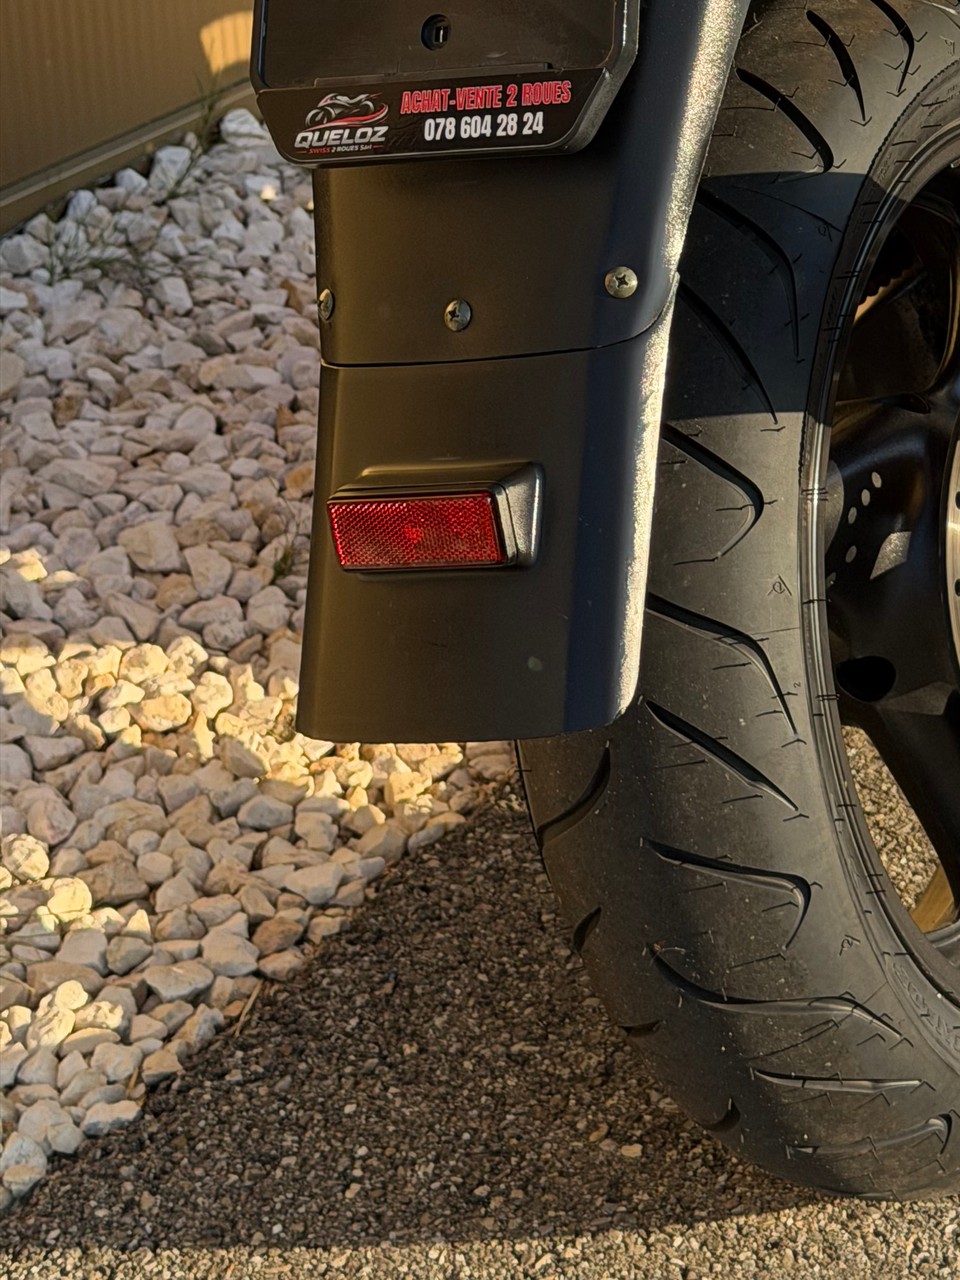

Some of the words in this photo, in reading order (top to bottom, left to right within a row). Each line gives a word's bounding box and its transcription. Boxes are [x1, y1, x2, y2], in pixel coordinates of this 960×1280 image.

[400, 84, 503, 115] ACHAT-VENTE
[506, 83, 519, 108] 2
[521, 80, 572, 107] ROUES
[293, 125, 389, 149] QUELOZ
[423, 117, 456, 141] 078
[460, 114, 492, 138] 604
[496, 112, 518, 137] 28
[522, 111, 545, 135] 24
